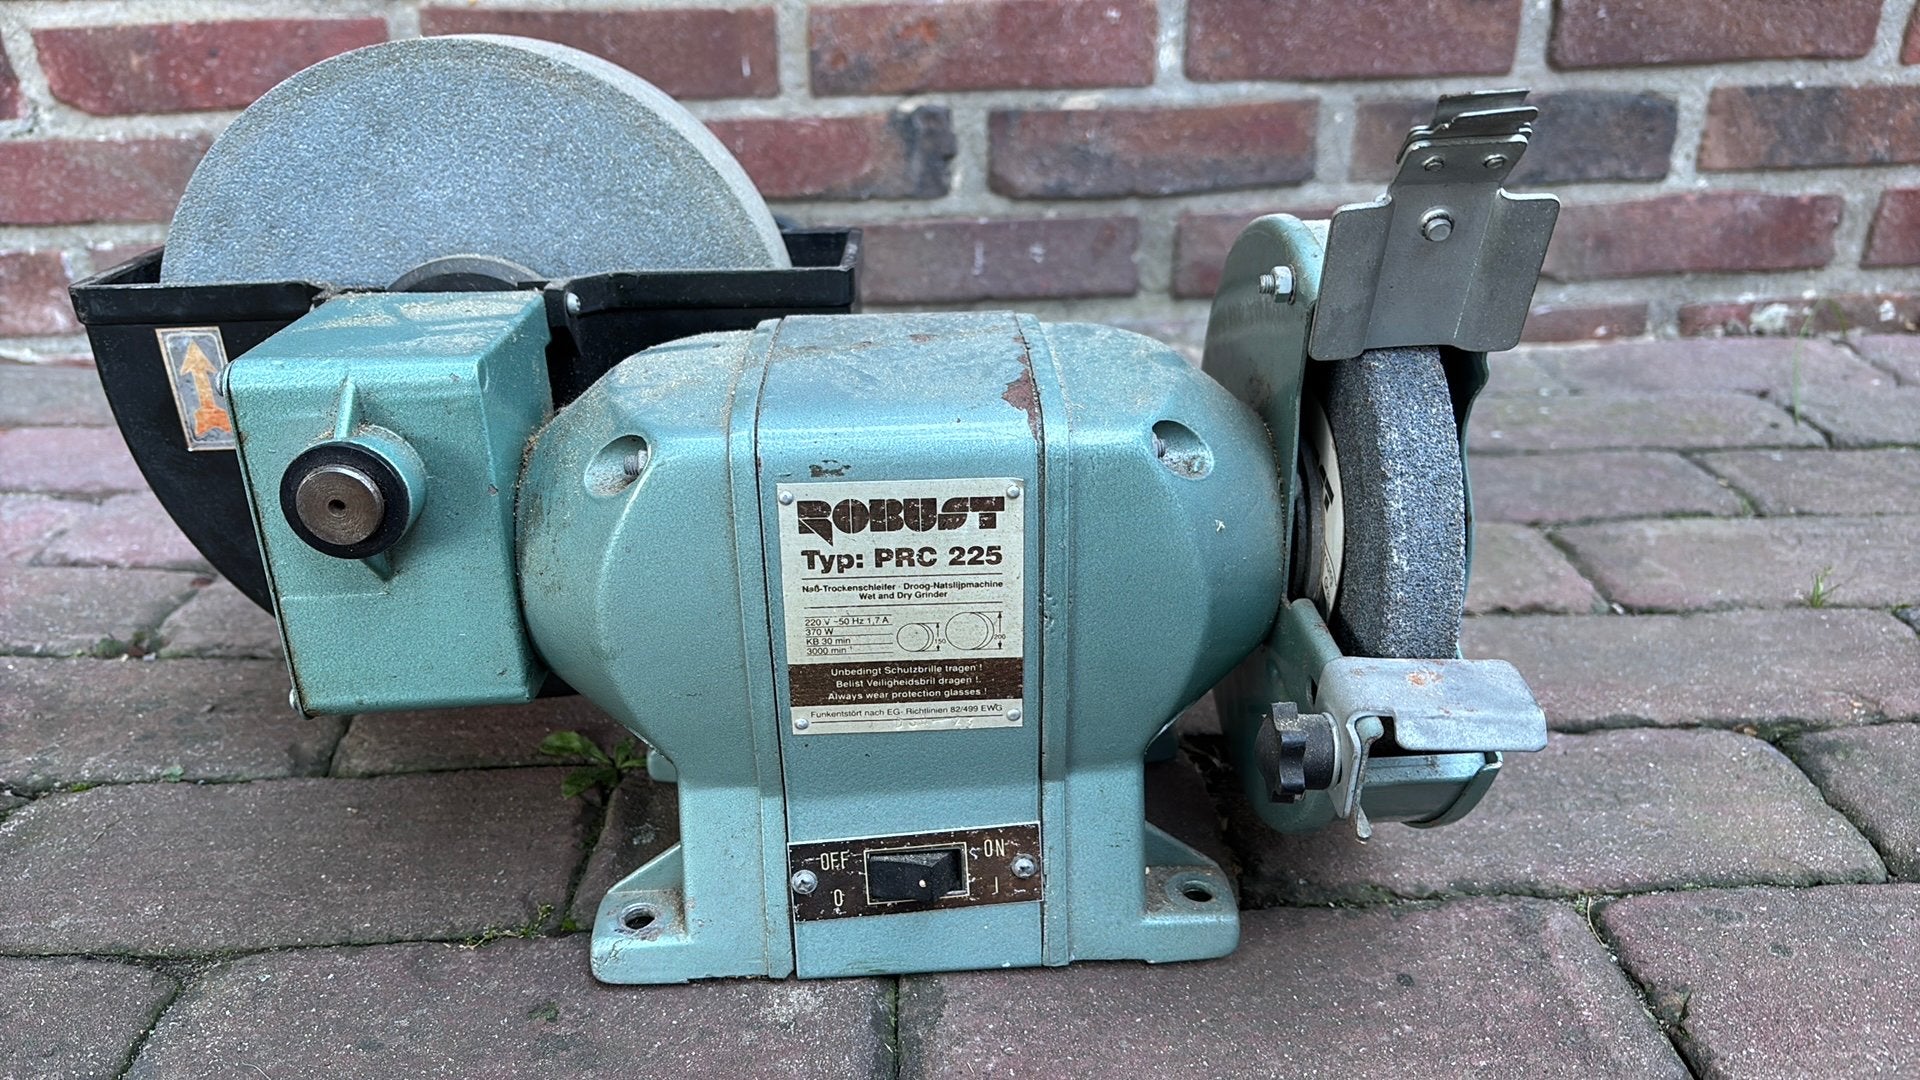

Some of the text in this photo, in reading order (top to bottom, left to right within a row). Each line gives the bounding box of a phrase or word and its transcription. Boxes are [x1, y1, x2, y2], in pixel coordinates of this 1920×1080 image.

[797, 496, 1005, 546] ROBUST
[801, 545, 1003, 574] Typ: PRC 225
[904, 580, 1003, 591] Droog-Natslijpmachine
[859, 592, 876, 600] Wet
[897, 591, 912, 600] Dry
[915, 590, 948, 599] Grinder
[805, 618, 821, 627] 220
[824, 618, 830, 626] V
[852, 617, 864, 625] Hz
[867, 616, 880, 626] 1,7
[882, 616, 889, 624] A
[805, 628, 822, 636] 370
[993, 633, 1006, 641] 200
[806, 637, 851, 646] KB 30 min
[806, 647, 829, 656] 3000
[831, 667, 882, 677] Unbedingt
[884, 664, 943, 674] Schutzbrille
[945, 664, 976, 674] tragen
[836, 680, 864, 688] Belist
[866, 677, 936, 689] Veiligheidsbril
[938, 676, 972, 686] dragen
[828, 691, 863, 701] Always
[866, 691, 889, 699] wear
[891, 688, 941, 700] protection
[944, 688, 981, 698] glasses
[810, 709, 862, 719] Funkentstört
[905, 706, 948, 715] Richtlinien
[950, 704, 978, 713] 82/499
[981, 703, 1003, 712] EWG
[983, 838, 1005, 858] ON
[820, 851, 849, 871] OFF
